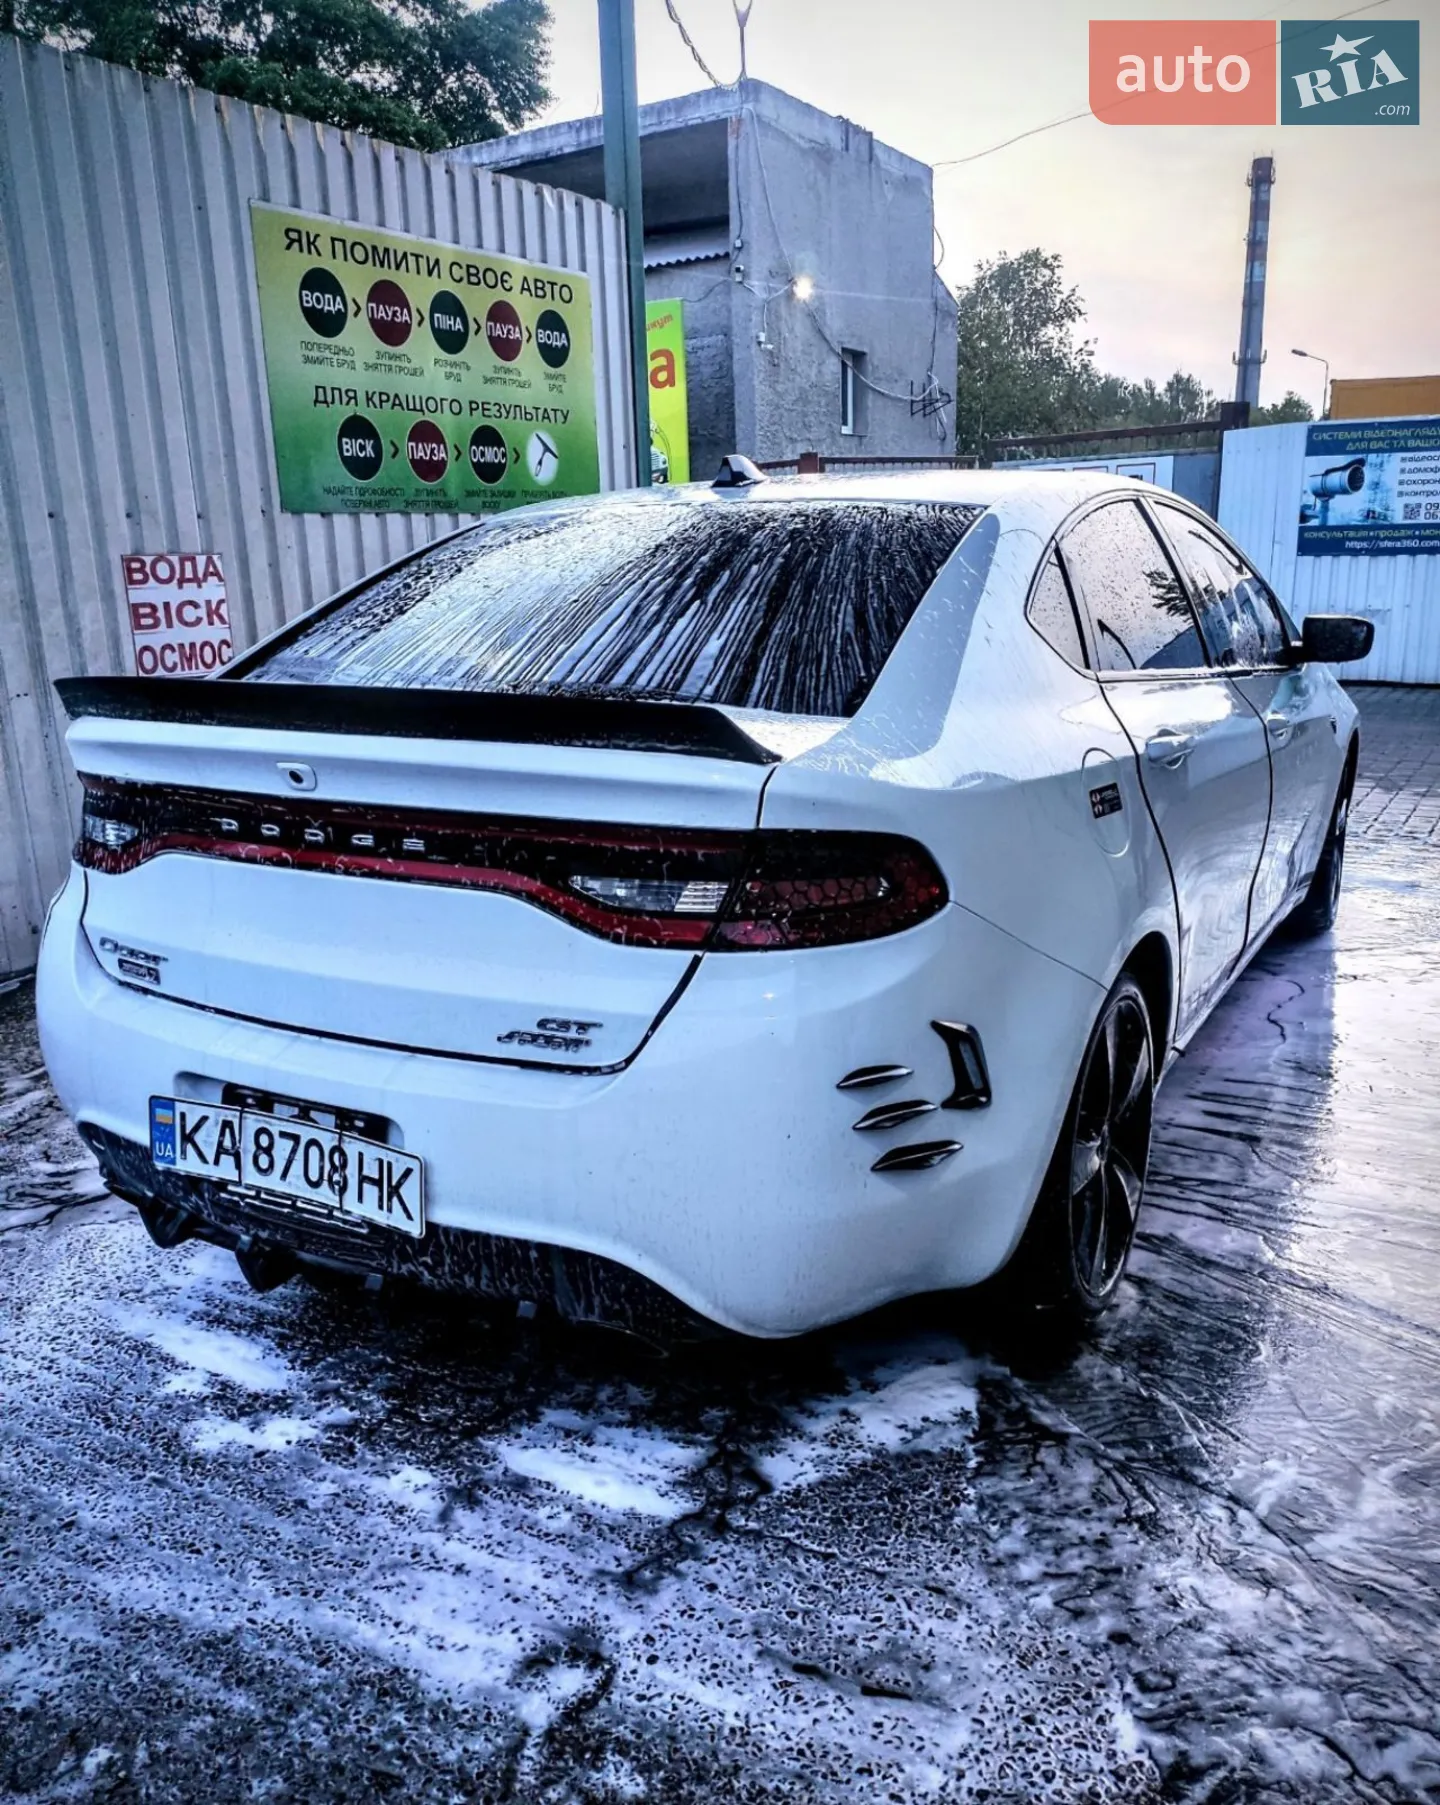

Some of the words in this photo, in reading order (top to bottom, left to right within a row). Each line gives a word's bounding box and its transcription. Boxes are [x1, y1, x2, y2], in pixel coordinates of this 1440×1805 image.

[284, 228, 322, 257] ЯК
[330, 236, 442, 280] ПОМИТИ
[449, 261, 513, 292] СВОЄ
[520, 275, 574, 304] АВТО
[301, 289, 345, 314] ВОДА
[367, 302, 411, 325] ПАУЗА
[433, 312, 464, 333] ПІНА
[486, 321, 522, 342] ПАУЗА
[537, 328, 569, 348] ВОДА
[300, 340, 355, 357] ПОПЕРЕДНЬО
[301, 354, 335, 367] ЗМИЙТЕ
[336, 358, 357, 371] БРУД
[394, 364, 425, 378] ГРОШЕЙ
[444, 371, 462, 383] БРУД
[313, 385, 359, 409] ДЛЯ
[364, 390, 463, 417] КРАЩОГО
[469, 400, 570, 425] РЕЗУЛЬТАТУ
[341, 437, 375, 459] ВІСК
[407, 441, 448, 462] ПАУЗА
[470, 445, 507, 465] ОСМОС
[1346, 441, 1369, 451] ДЛЯ
[1369, 440, 1390, 450] ВАС
[1392, 439, 1406, 449] ТА
[1424, 511, 1440, 521] 06
[124, 555, 224, 589] ВОДА
[131, 599, 229, 630] ВІСК
[137, 638, 233, 675] ОСМОС
[221, 817, 425, 851] DODGE
[154, 1141, 175, 1158] UA
[179, 1111, 242, 1172] KA
[251, 1126, 350, 1198] 8708
[357, 1150, 415, 1222] HK
